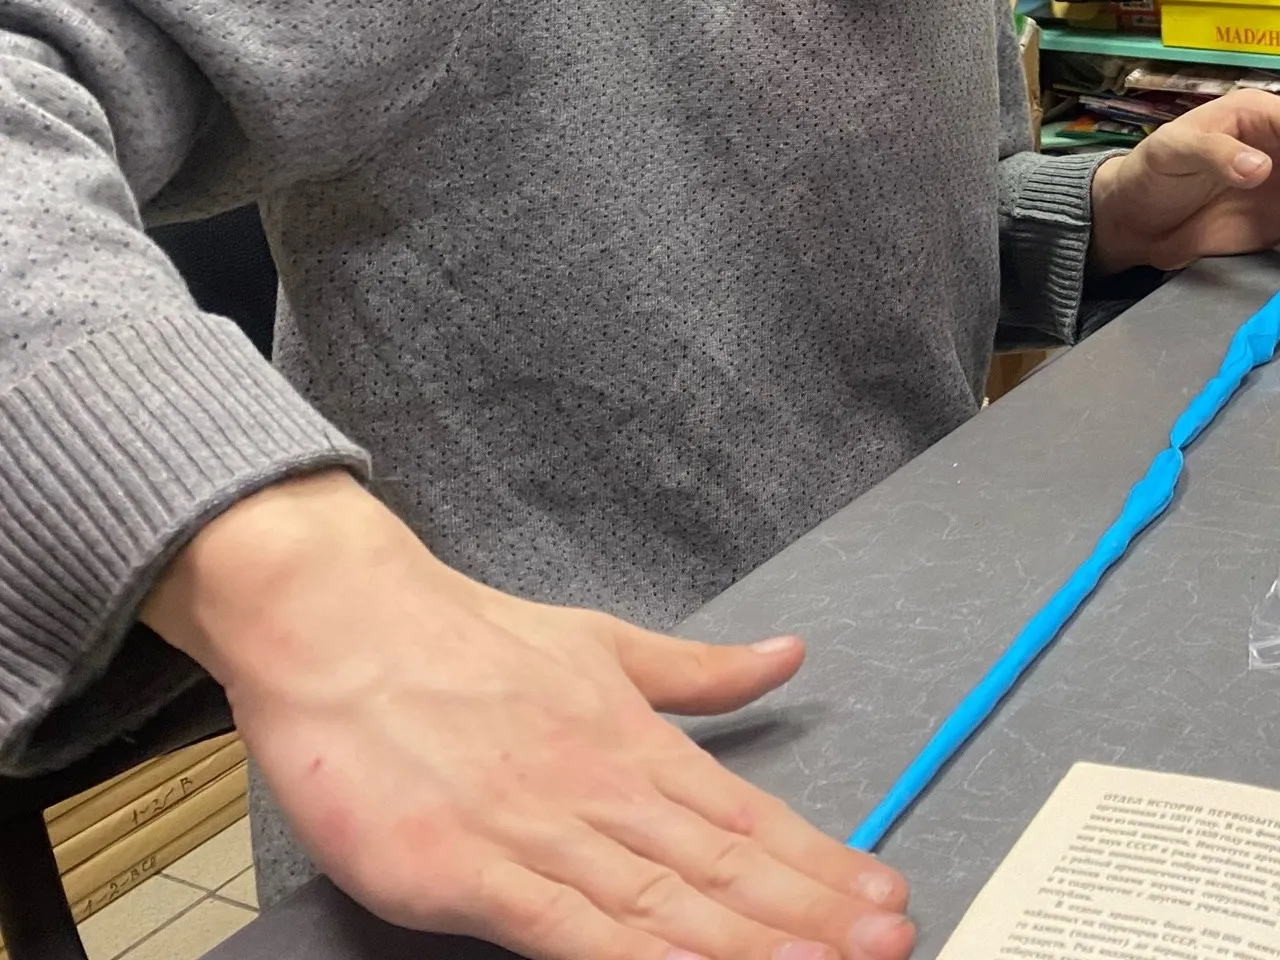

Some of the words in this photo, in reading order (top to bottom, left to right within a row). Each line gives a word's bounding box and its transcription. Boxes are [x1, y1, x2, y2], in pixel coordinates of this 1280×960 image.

[1103, 793, 1144, 806] ОТДЕЛ
[1147, 798, 1204, 814] ИСТОРИИ
[1126, 841, 1159, 852] СССР
